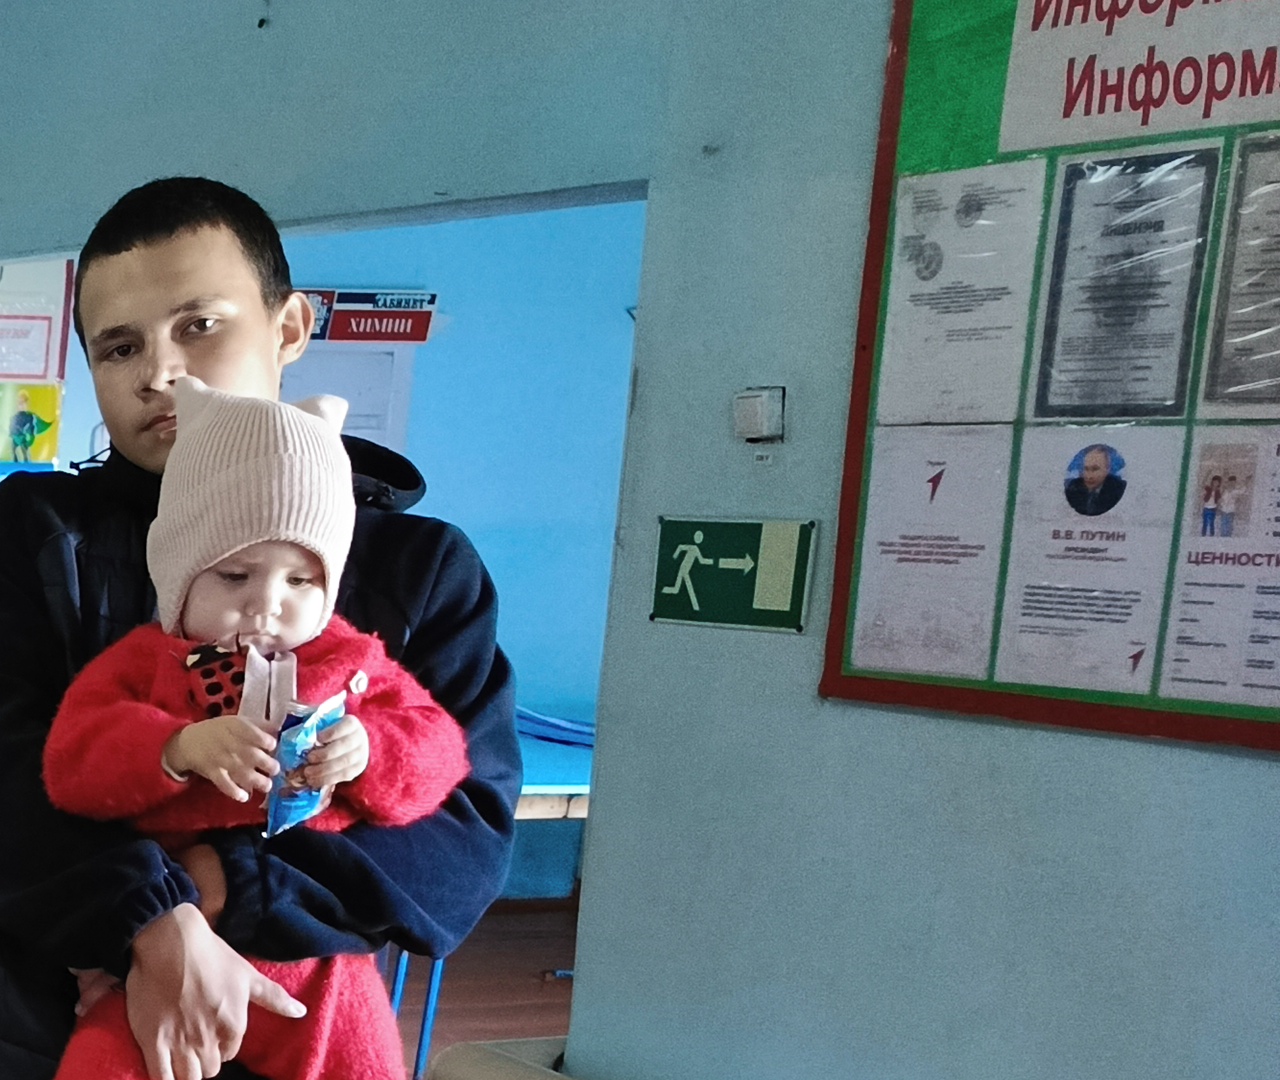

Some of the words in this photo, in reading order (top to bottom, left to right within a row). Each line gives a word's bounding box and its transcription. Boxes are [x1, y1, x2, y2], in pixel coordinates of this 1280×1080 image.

[1062, 45, 1280, 127] Информ
[372, 294, 429, 310] КАБИНЕТ
[348, 317, 413, 334] ХИМИИ
[1080, 530, 1127, 542] ПУТИН
